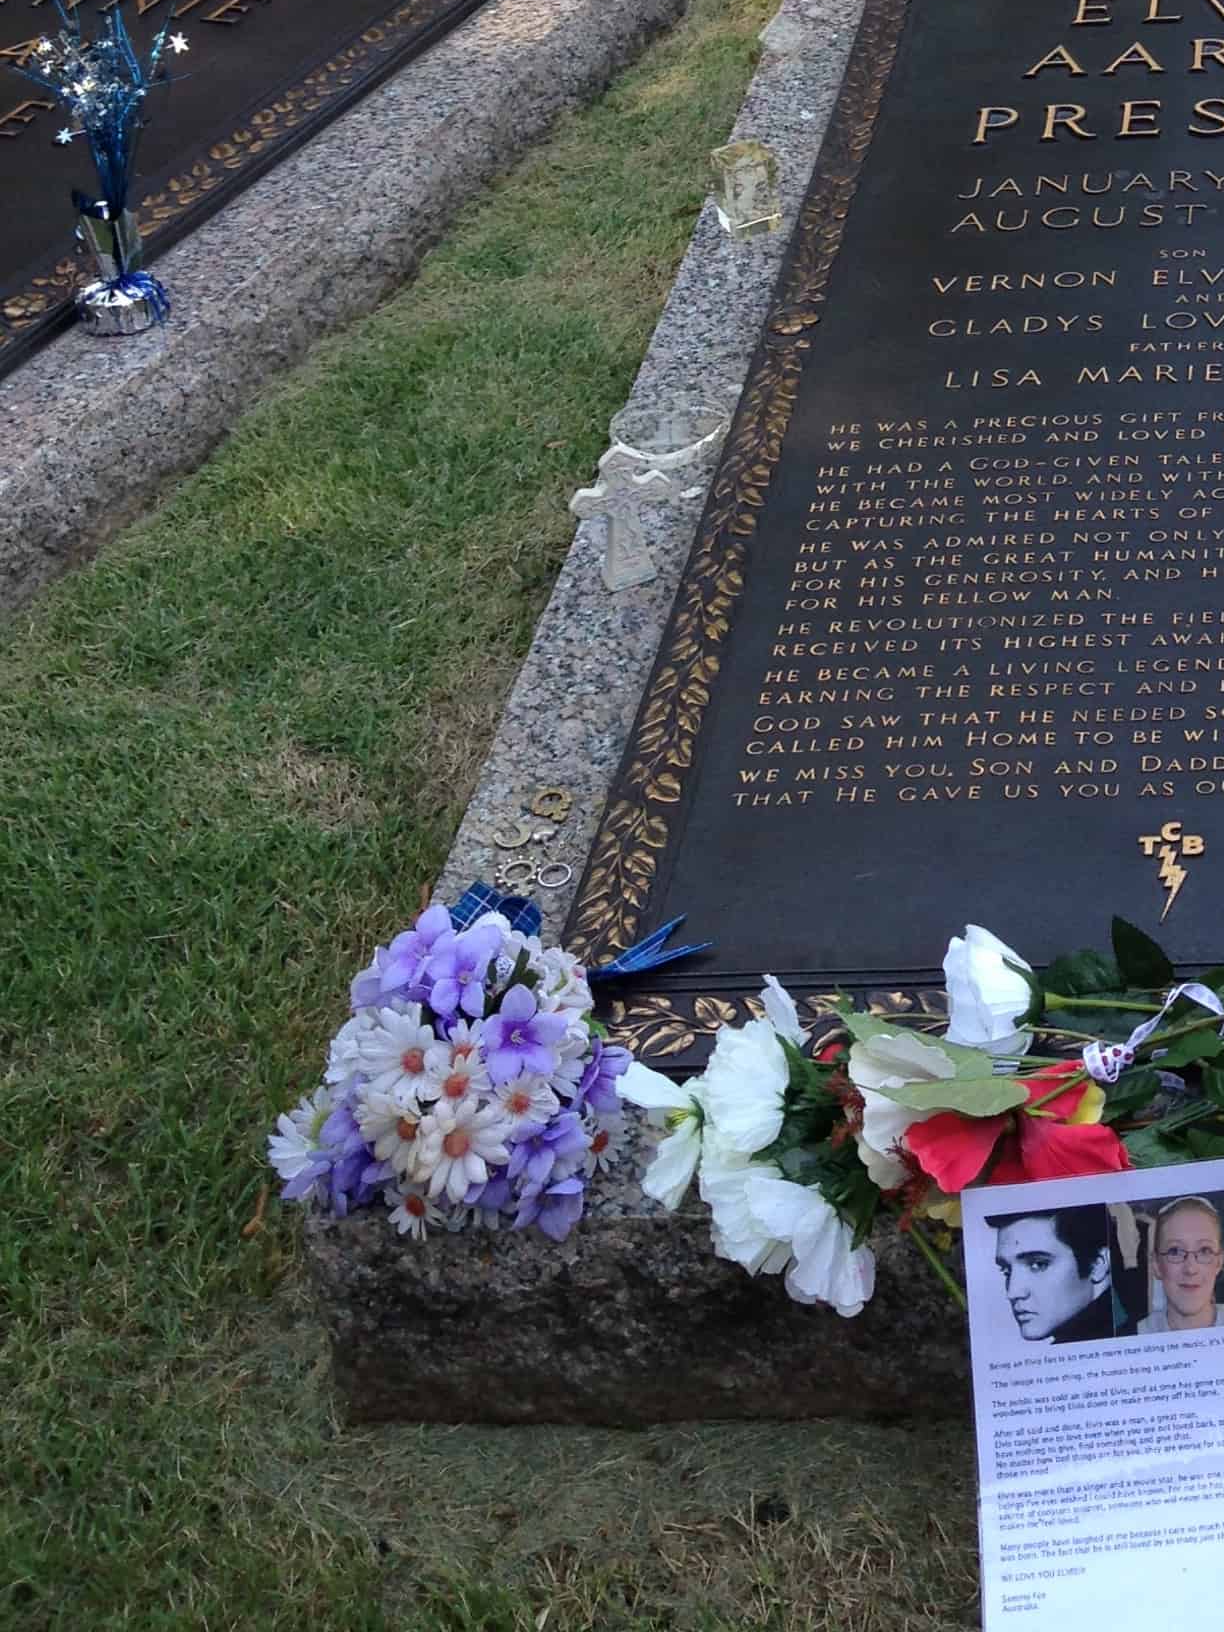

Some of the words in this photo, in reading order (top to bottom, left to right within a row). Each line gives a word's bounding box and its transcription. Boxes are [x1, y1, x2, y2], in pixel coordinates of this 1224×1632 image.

[949, 203, 1208, 233] AUGUST
[1159, 249, 1206, 259] SON
[931, 270, 1118, 294] VERNON
[928, 314, 1103, 337] GLADYS
[1129, 340, 1224, 353] FATHER
[945, 368, 1043, 389] LISA
[1076, 363, 1223, 385] MARIE
[829, 423, 862, 436] HE
[876, 420, 928, 433] WAS
[943, 419, 959, 430] A
[972, 413, 1103, 429] PRECIOUS
[1119, 411, 1182, 424] GIFT
[826, 440, 861, 452] WE
[878, 432, 1027, 450] CHERISHED
[1044, 430, 1099, 443] AND
[1117, 428, 1206, 441] LOVED
[817, 465, 851, 479] HE
[866, 461, 923, 475] HAD
[937, 460, 953, 473] A
[805, 512, 965, 531] CAPTURING
[985, 509, 1036, 524] THE
[1053, 507, 1160, 521] HEARTS
[1178, 506, 1213, 519] OF
[777, 621, 812, 636] HE
[828, 613, 1085, 634] REVOLUTIONIZED
[1100, 612, 1154, 625] THE
[772, 639, 919, 657] RECEIVED
[939, 637, 983, 652] ITS
[1003, 633, 1133, 649] HIGHEST
[745, 736, 865, 755] CALLED
[885, 735, 943, 749] HIM
[1073, 730, 1115, 745] TO
[1132, 729, 1163, 744] BE
[738, 768, 781, 784] WE
[794, 764, 865, 782] MISS
[1053, 759, 1118, 775] AND
